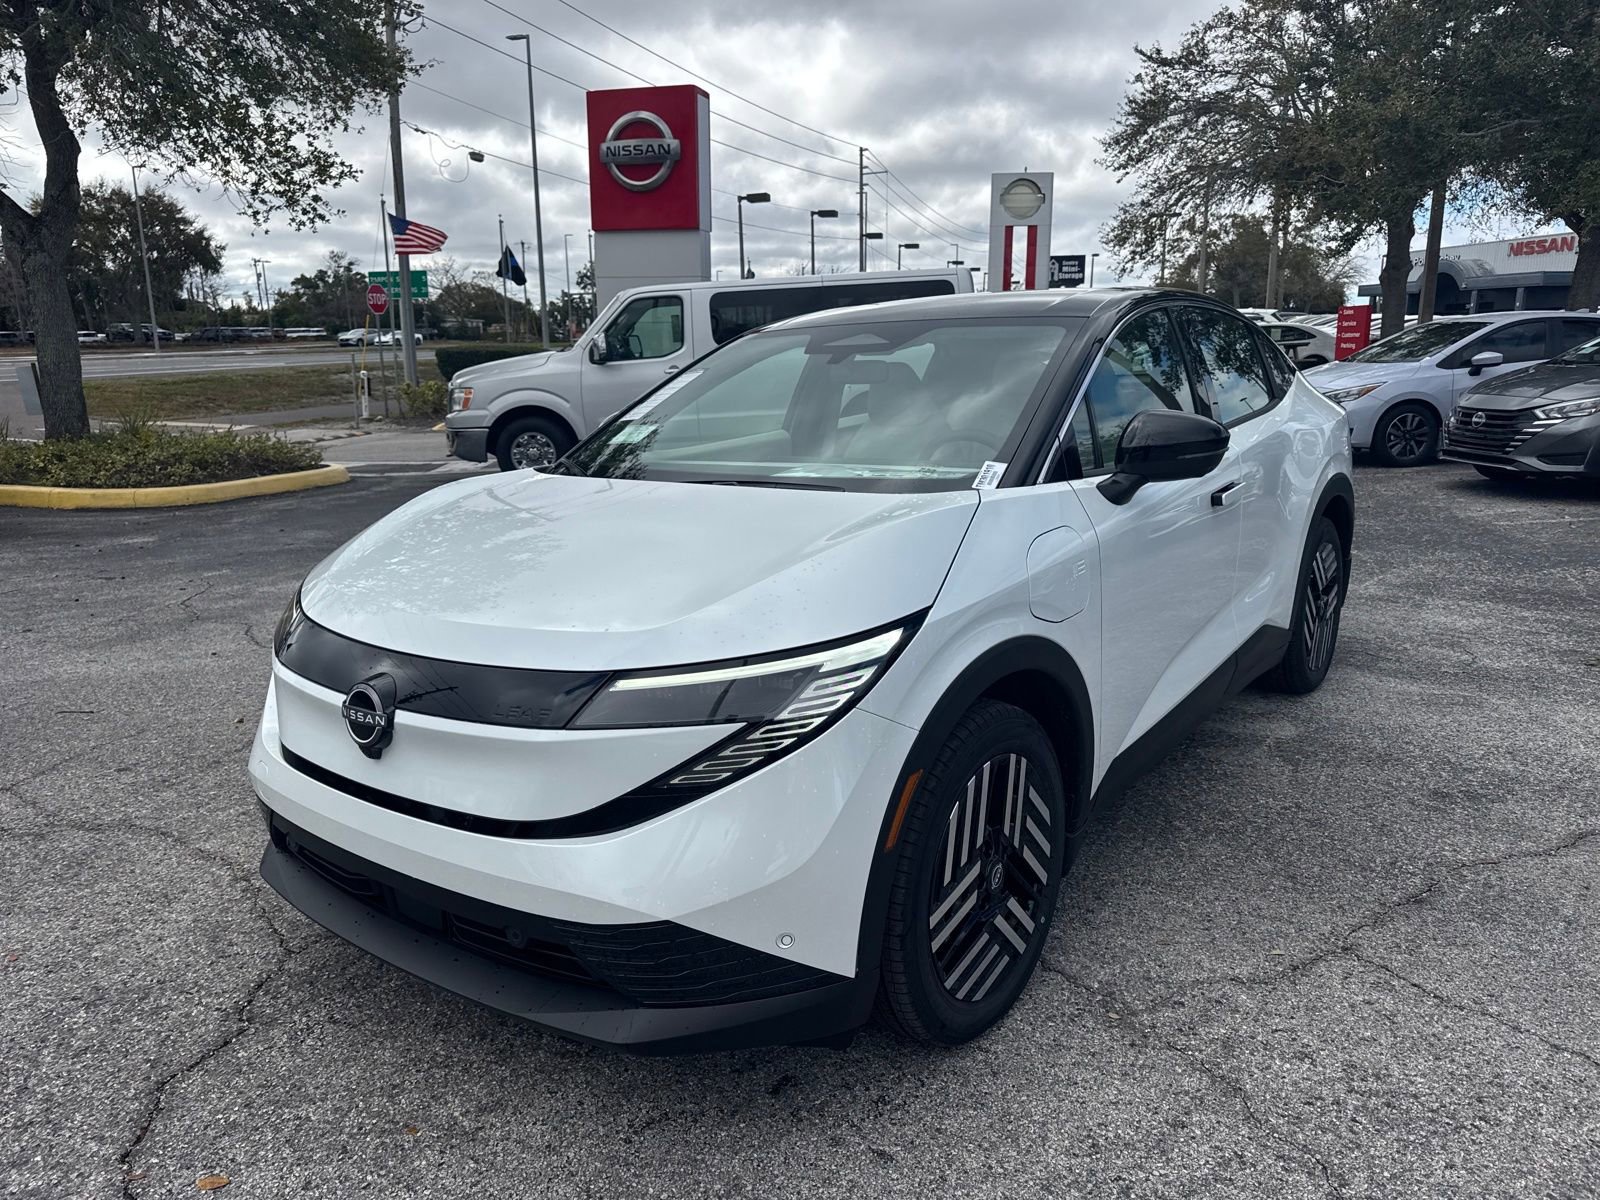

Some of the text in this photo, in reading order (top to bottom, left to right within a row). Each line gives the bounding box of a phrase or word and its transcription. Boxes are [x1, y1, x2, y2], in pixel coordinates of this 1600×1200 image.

[606, 144, 671, 157] NISSAN
[1508, 235, 1576, 257] NISSAN
[368, 293, 386, 304] STOP
[1340, 342, 1356, 350] Parking
[343, 706, 385, 725] NISSAN
[494, 704, 552, 719] LEAF
